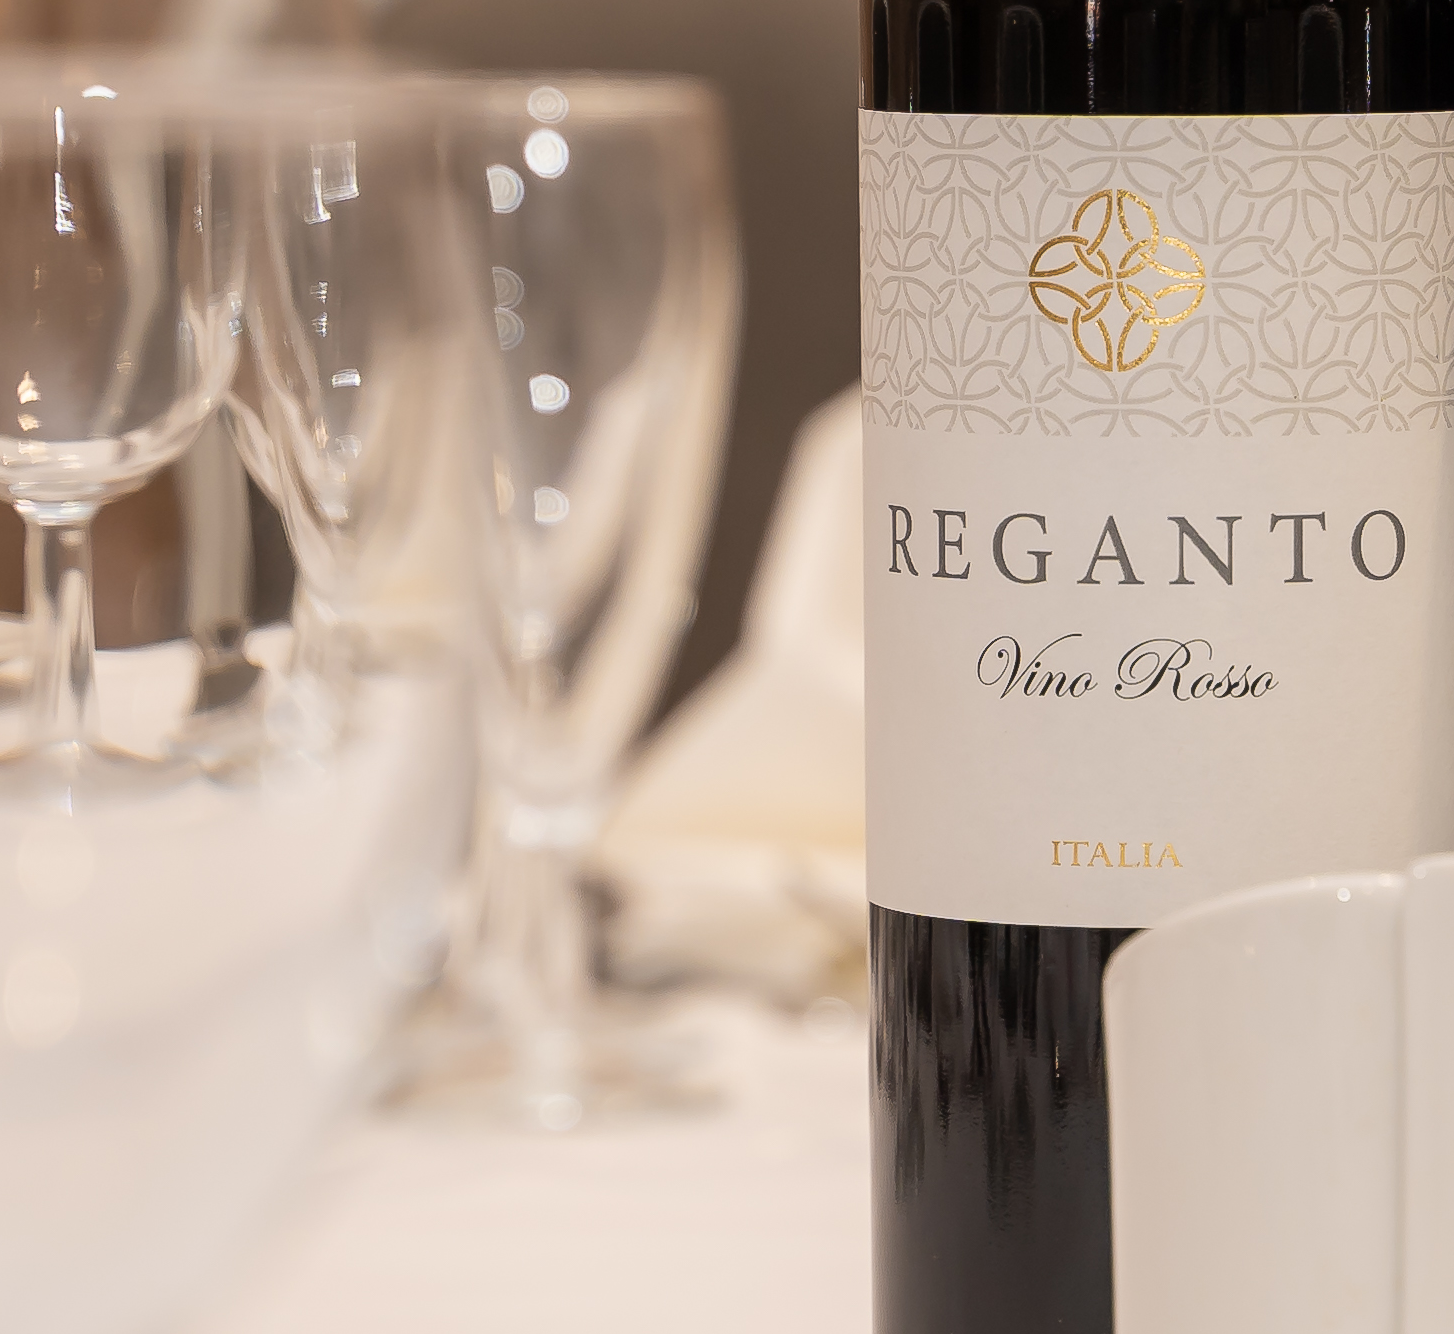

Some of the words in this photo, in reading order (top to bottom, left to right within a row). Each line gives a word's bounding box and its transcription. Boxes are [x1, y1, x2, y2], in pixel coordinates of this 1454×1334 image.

[887, 503, 1407, 587] REGANTO
[976, 632, 1099, 701] Vino
[1113, 637, 1281, 702] Rosso
[1051, 840, 1184, 868] ITALIA
